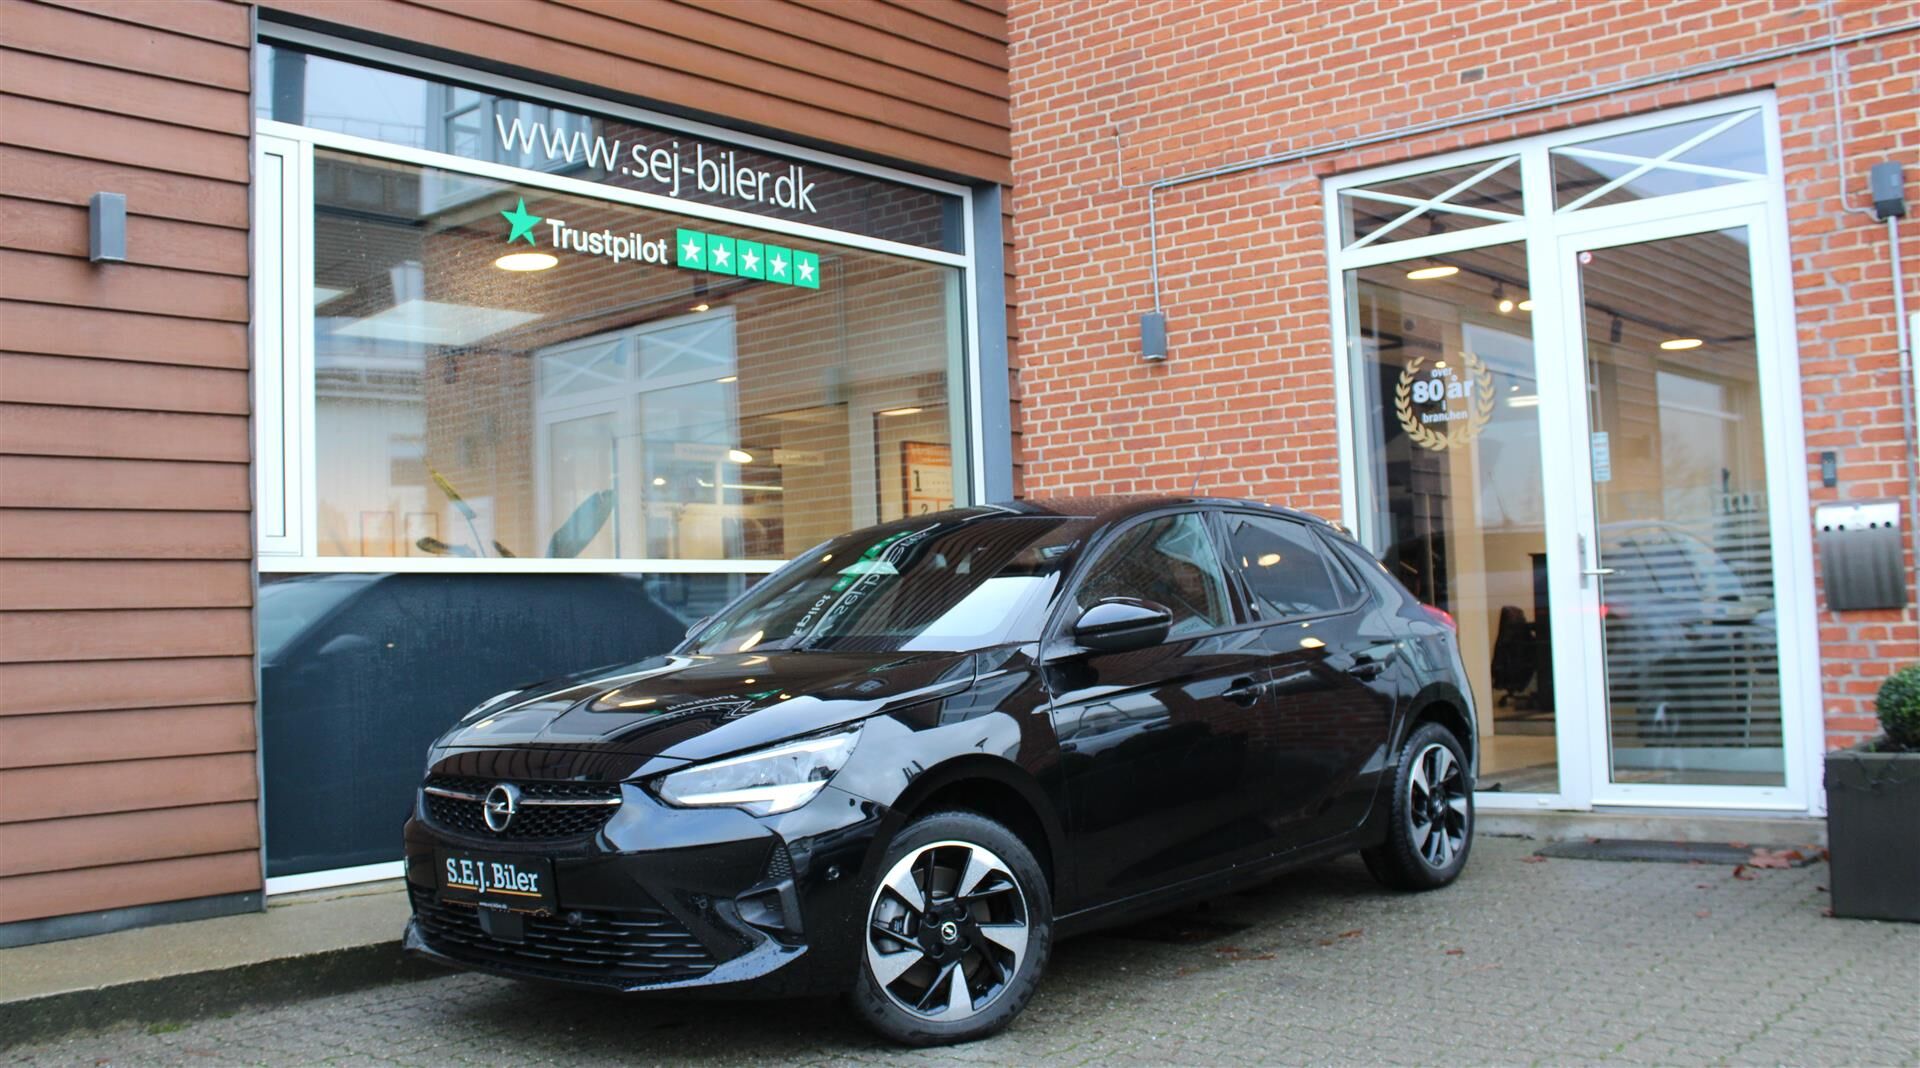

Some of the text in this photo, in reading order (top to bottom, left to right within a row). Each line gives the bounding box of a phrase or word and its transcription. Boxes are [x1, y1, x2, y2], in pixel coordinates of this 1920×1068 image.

[496, 113, 817, 214] www.sej-biler.dk
[546, 218, 669, 265] Trustpilot
[1431, 367, 1453, 378] over
[1412, 375, 1473, 403] 80 år
[1422, 411, 1468, 423] branchen
[912, 469, 923, 493] 1
[446, 858, 538, 892] S.E.J. Biler
